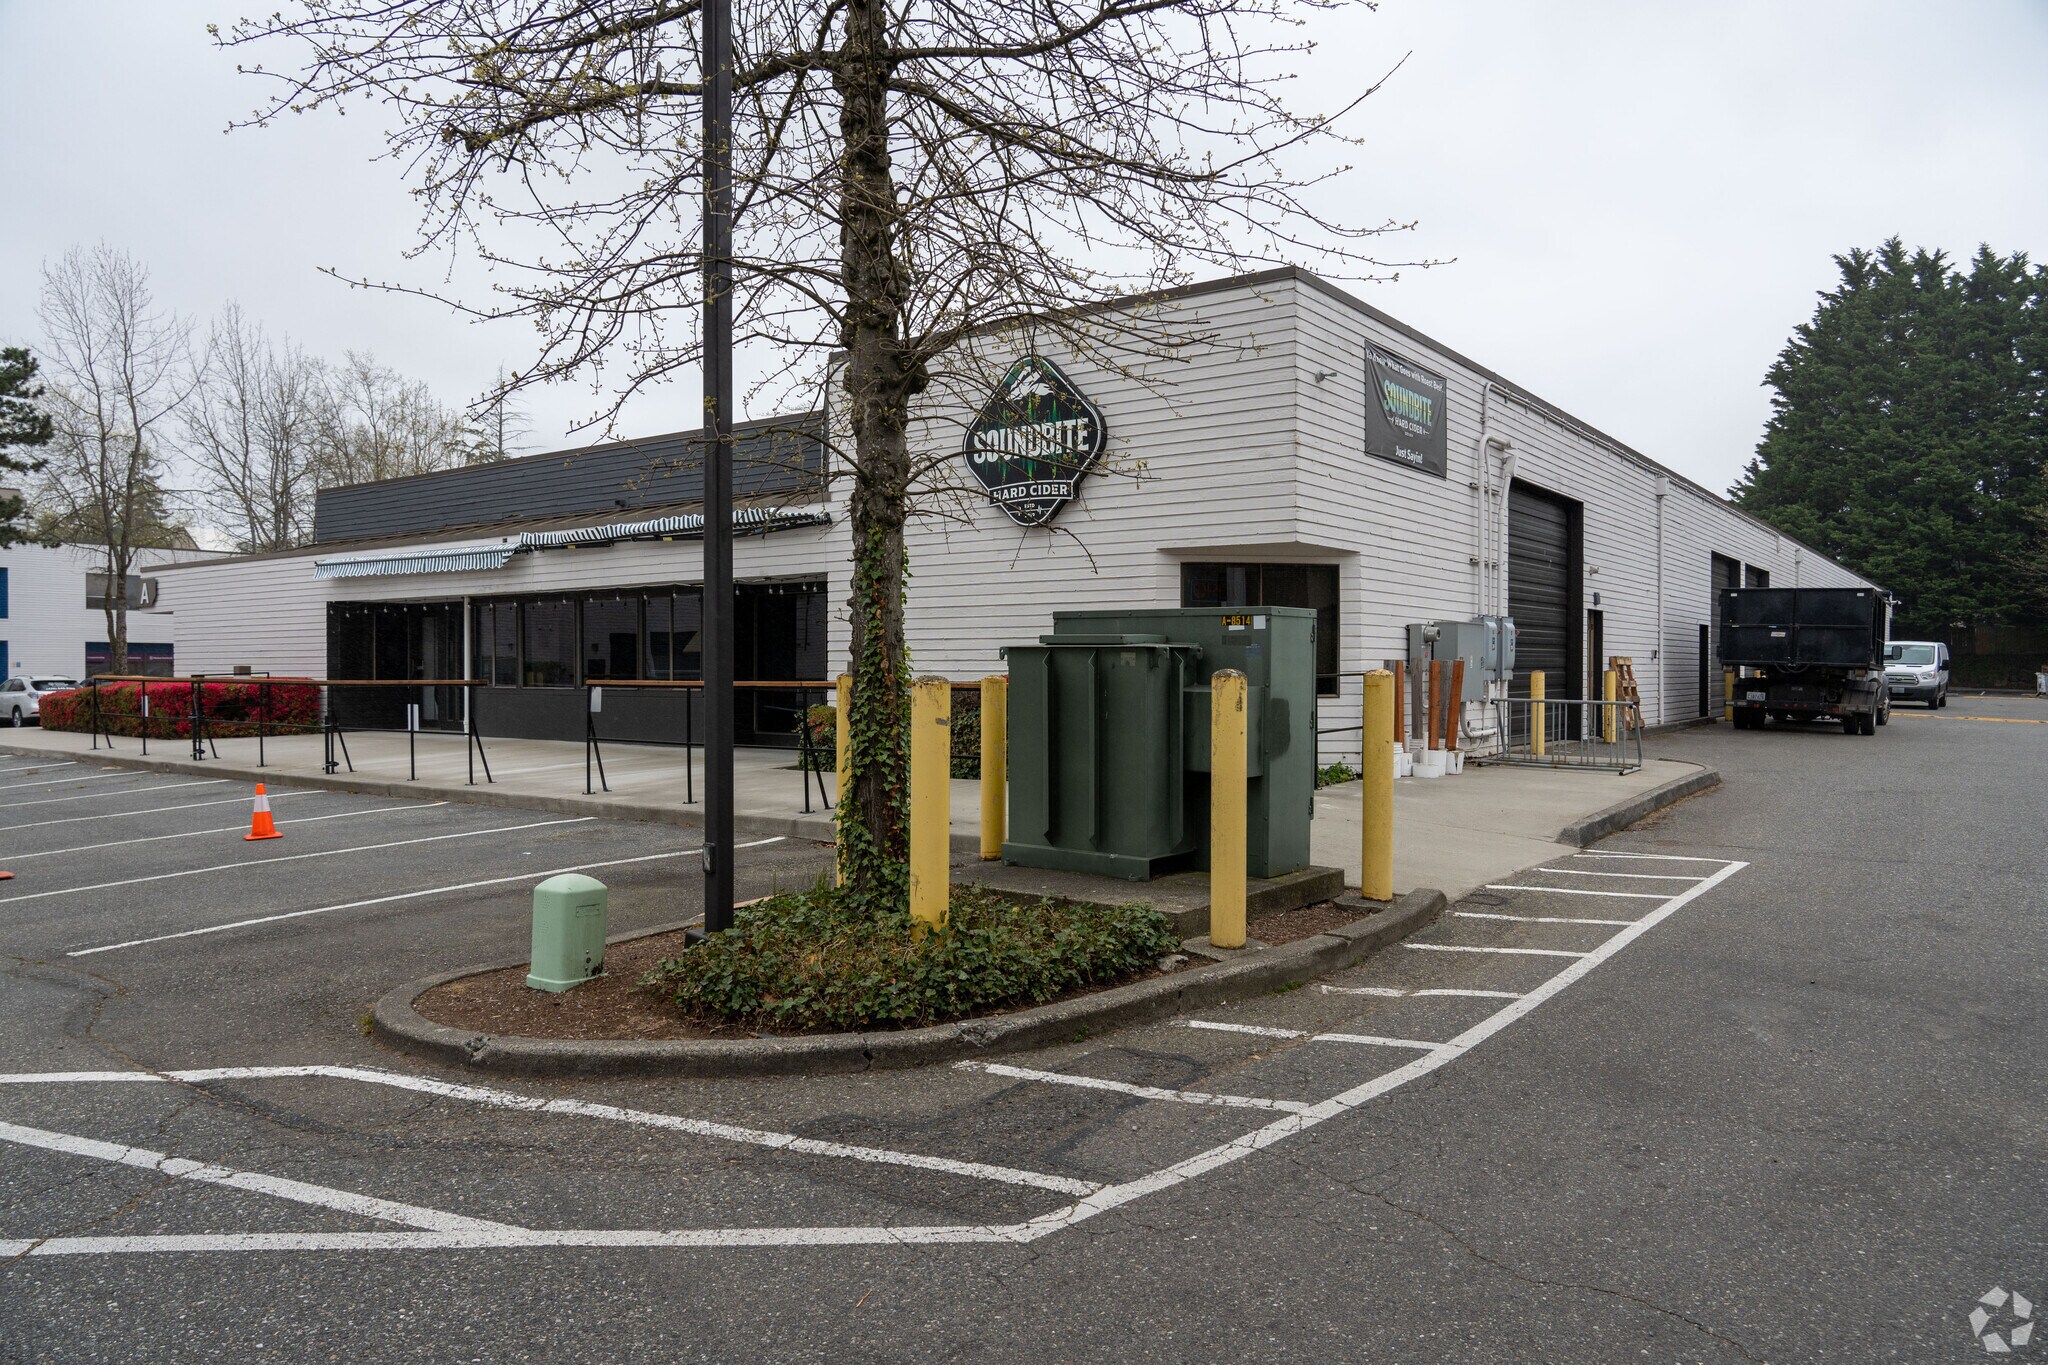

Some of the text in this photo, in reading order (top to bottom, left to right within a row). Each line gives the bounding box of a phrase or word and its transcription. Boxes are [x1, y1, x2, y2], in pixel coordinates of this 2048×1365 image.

[1386, 358, 1400, 372] What
[1399, 365, 1411, 378] Goes
[1411, 371, 1421, 382] with
[1383, 379, 1432, 427] SOUNDBITE
[1394, 416, 1409, 429] HARD
[1409, 422, 1423, 435] CIDER
[973, 418, 1089, 464] SOUNDBITE
[1395, 445, 1407, 459] Just
[993, 484, 1069, 502] HARD CIDER
[140, 583, 149, 604] A
[1221, 615, 1250, 626] A-8514
